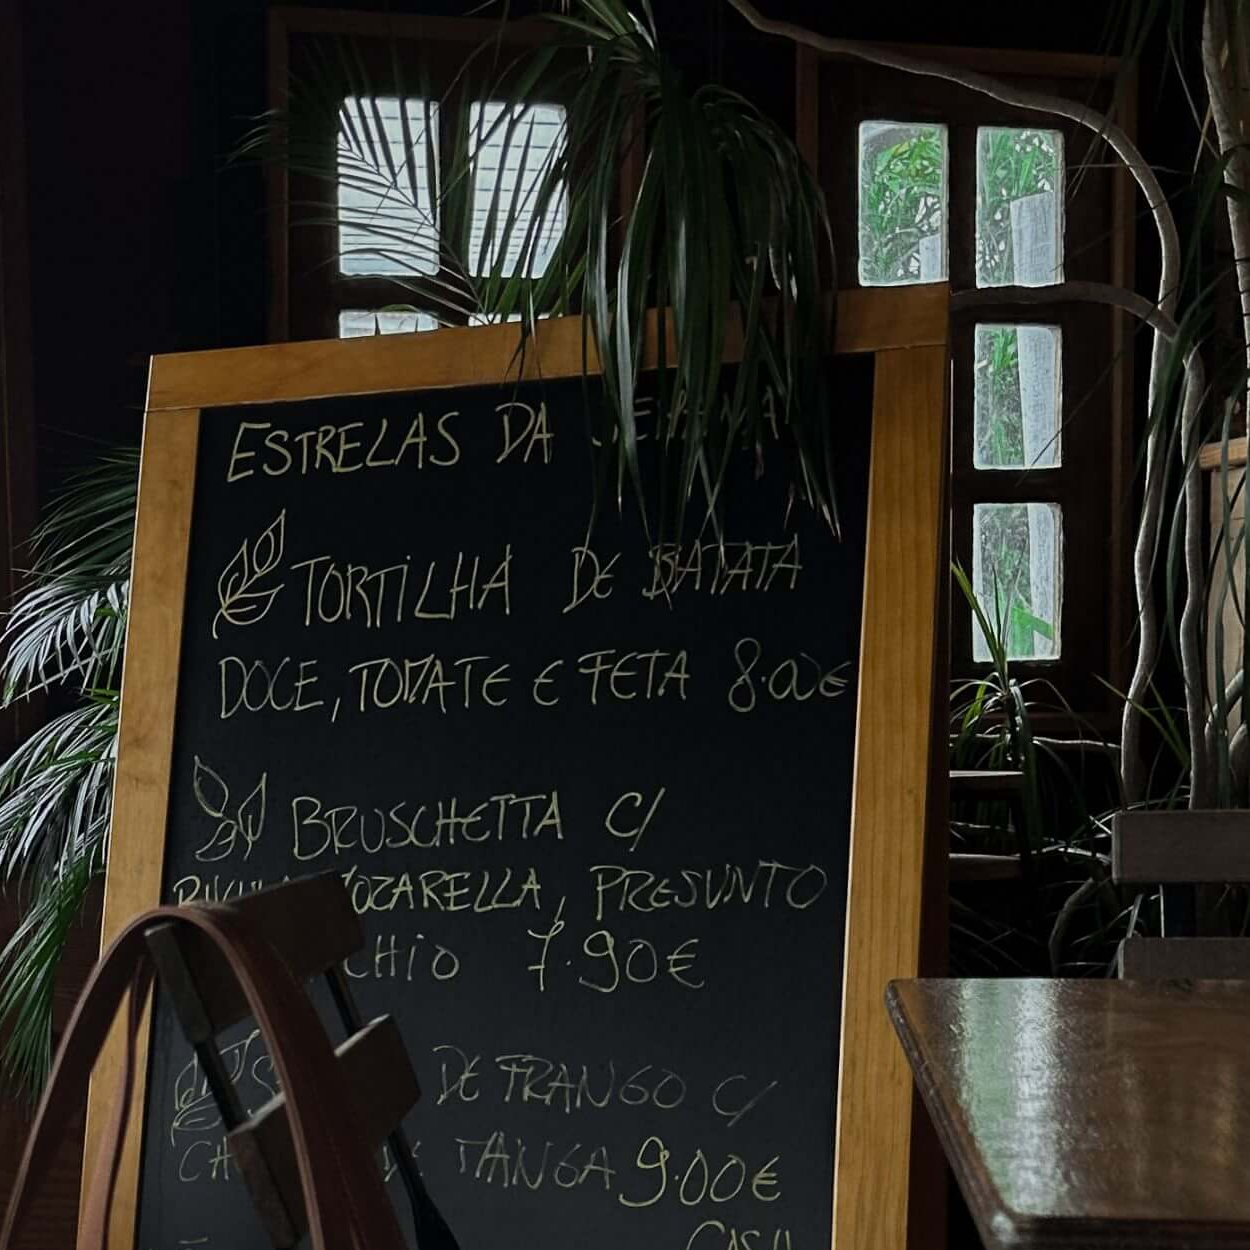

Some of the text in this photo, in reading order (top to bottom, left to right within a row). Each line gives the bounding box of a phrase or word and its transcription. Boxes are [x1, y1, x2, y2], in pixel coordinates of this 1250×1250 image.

[226, 411, 461, 483] ESTRELAS
[494, 401, 555, 464] DA
[562, 546, 621, 614] DE
[642, 532, 803, 602] BATATA
[532, 659, 564, 707] E
[578, 649, 691, 705] FETA
[291, 790, 565, 862] BRUSCHETTA
[590, 860, 828, 920] PRESUNTO
[527, 921, 706, 993] 7.90€
[432, 1045, 481, 1105] DE
[495, 1054, 687, 1115] FRANGO
[619, 1136, 783, 1207] 9.00€
